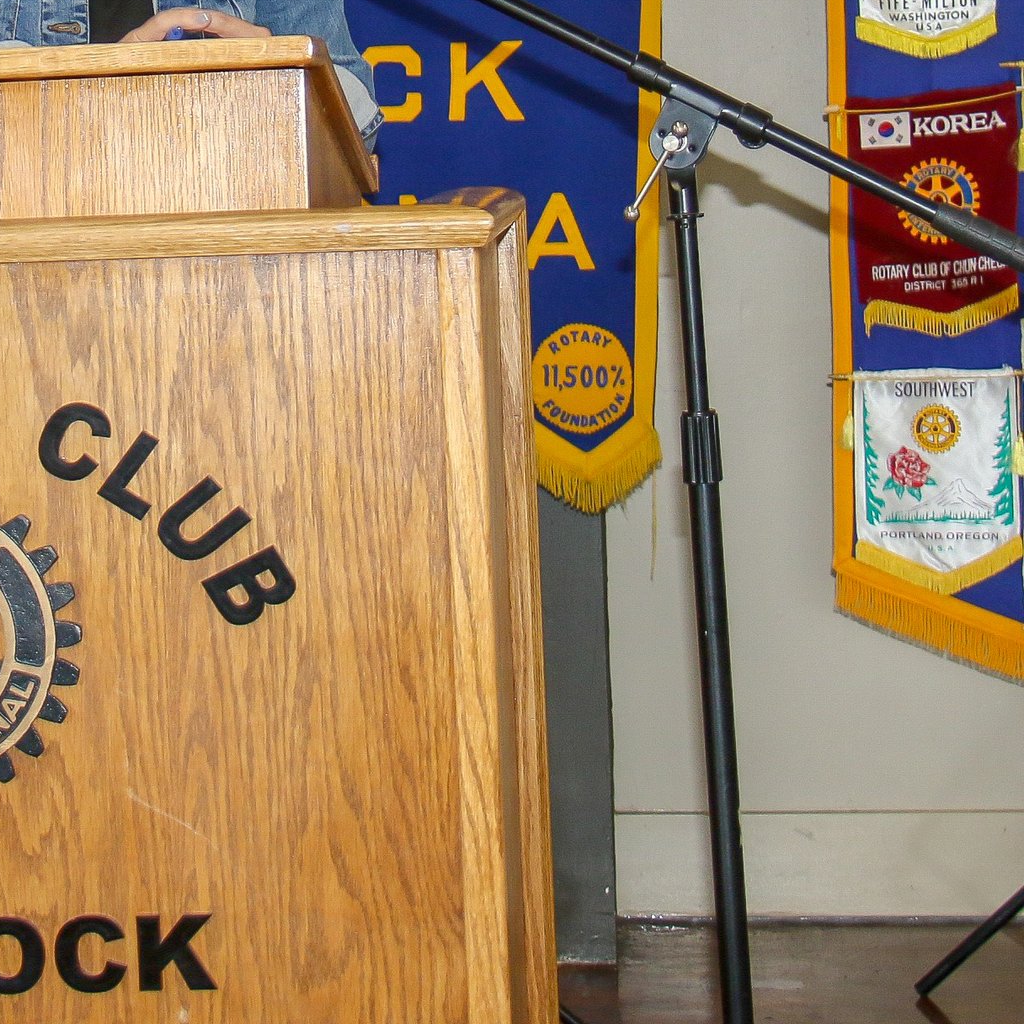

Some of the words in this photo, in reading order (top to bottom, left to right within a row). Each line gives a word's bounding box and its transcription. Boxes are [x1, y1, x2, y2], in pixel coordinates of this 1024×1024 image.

[889, 10, 970, 22] WASHINGTON
[912, 110, 1007, 137] KOREA
[872, 264, 910, 281] ROTARY
[912, 262, 937, 278] CLUB
[940, 261, 951, 276] OF
[953, 258, 976, 275] CHUN
[904, 280, 945, 292] DISTRICT
[549, 331, 612, 354] ROTARY
[543, 364, 625, 391] 11,500%
[895, 382, 976, 398] SOUTHWEST
[543, 393, 625, 427] FOUNDATION
[39, 401, 298, 626] CLUB
[947, 531, 1000, 540] OREGON
